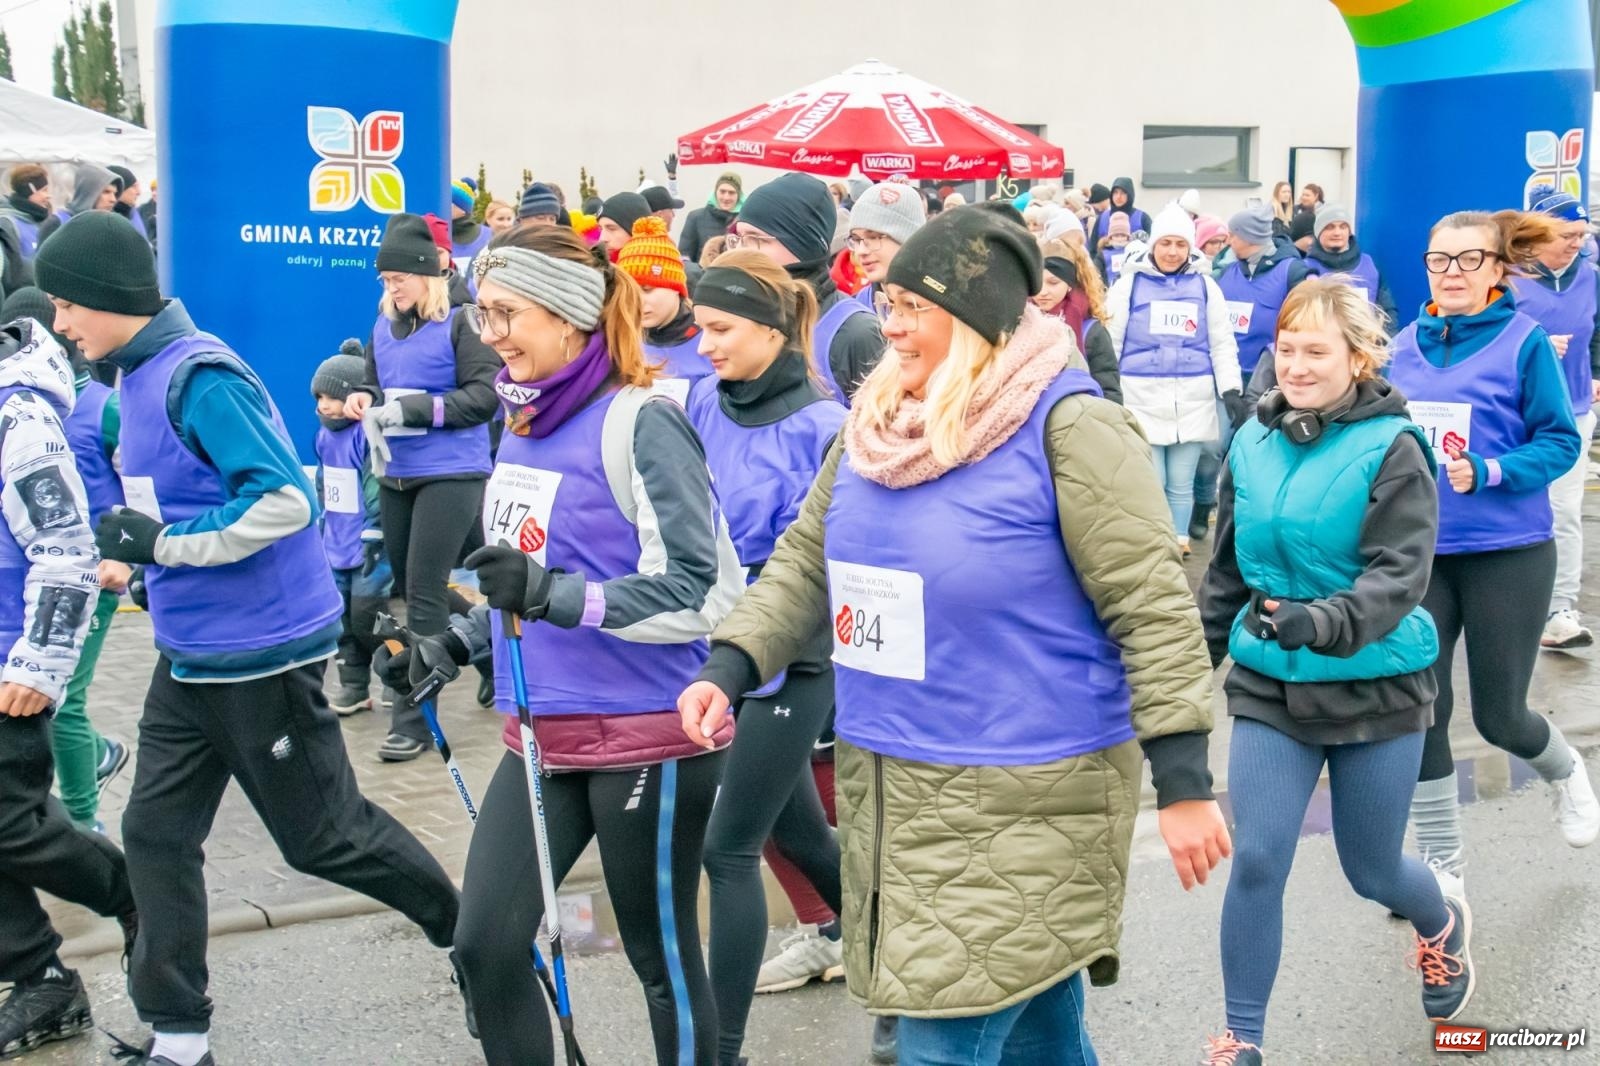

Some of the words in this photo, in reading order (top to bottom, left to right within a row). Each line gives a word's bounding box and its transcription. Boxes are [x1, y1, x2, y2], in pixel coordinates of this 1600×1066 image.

[783, 94, 844, 137] WARKA
[887, 95, 931, 143] WARKA
[792, 148, 834, 163] Classic
[866, 157, 910, 169] WARKA
[944, 154, 985, 171] Classic
[240, 224, 313, 244] GMINA
[319, 225, 382, 247] KRZYŻ
[287, 255, 323, 268] odkryj
[331, 257, 367, 269] poznaj
[1164, 313, 1188, 326] 107
[489, 499, 531, 536] 147
[853, 609, 884, 652] 84
